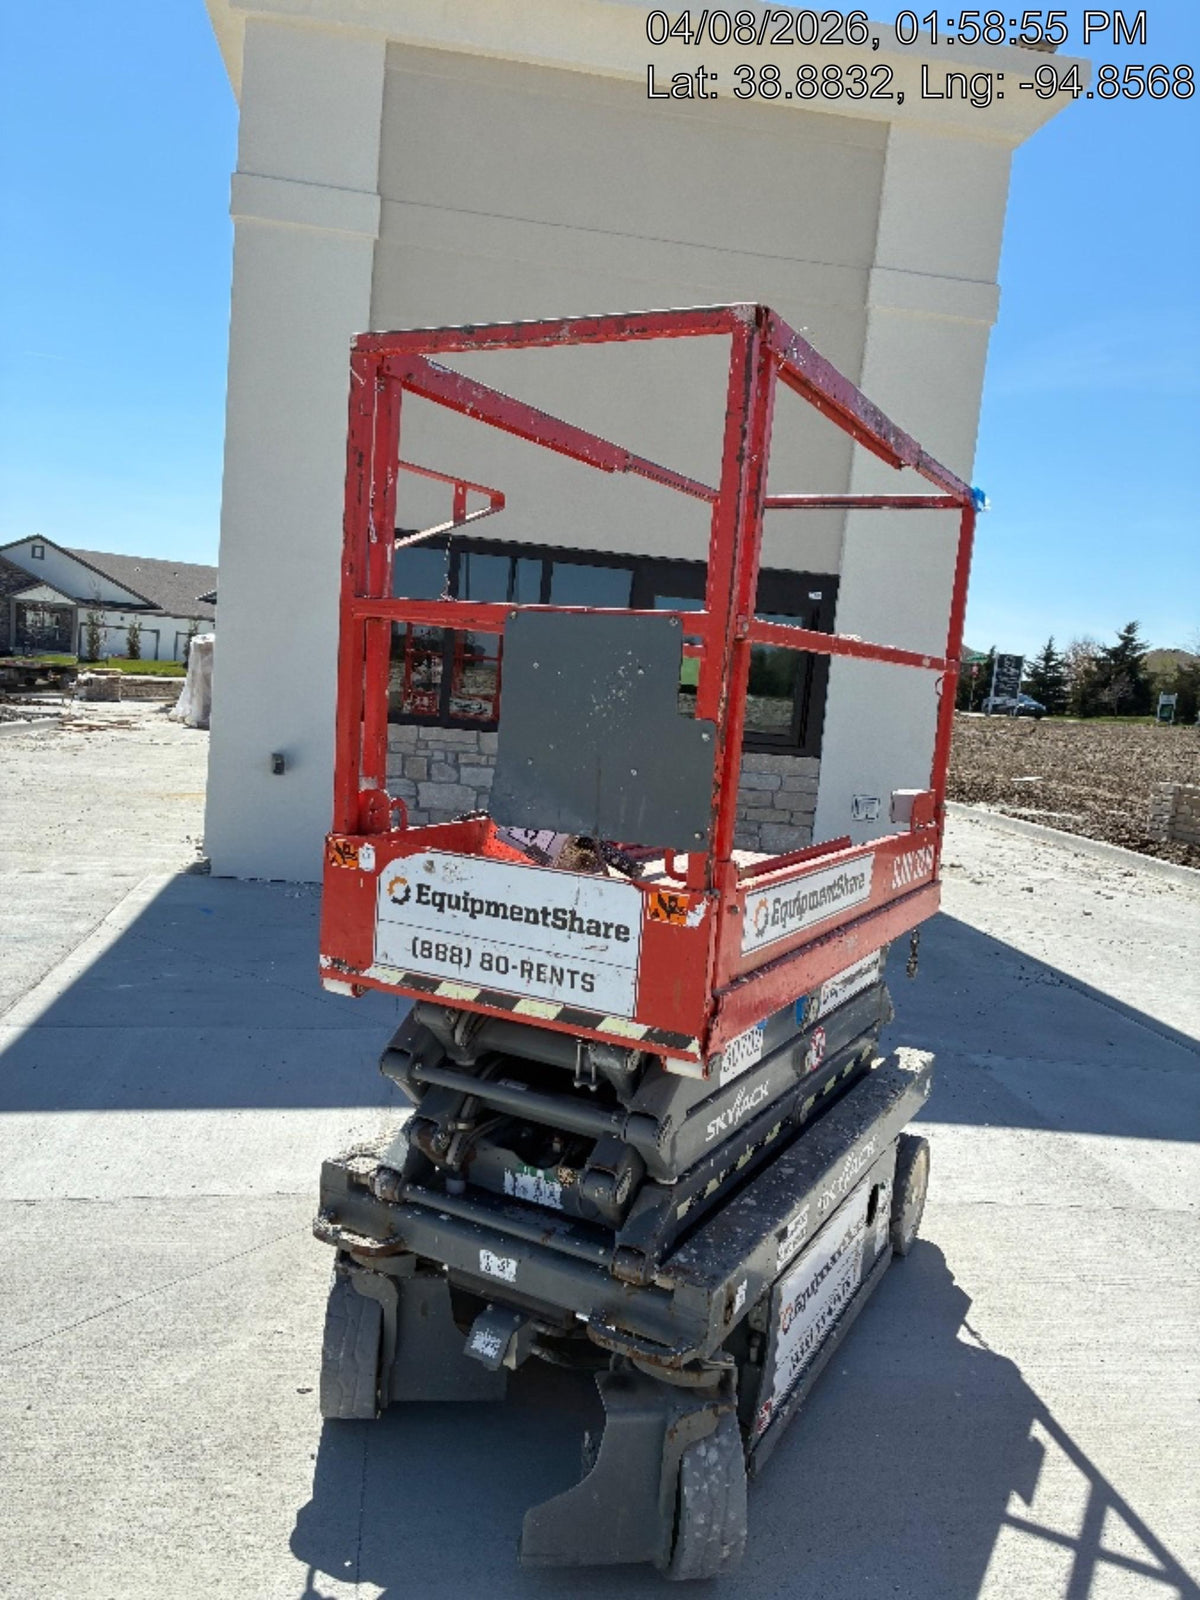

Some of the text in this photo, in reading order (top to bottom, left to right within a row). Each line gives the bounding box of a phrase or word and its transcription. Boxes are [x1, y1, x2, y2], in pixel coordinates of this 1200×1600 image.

[415, 883, 631, 943] EquipmentShare
[770, 872, 866, 929] EquipmentShare
[411, 936, 596, 993] (888) 80-RENTS
[705, 1080, 770, 1142] SKYJACK
